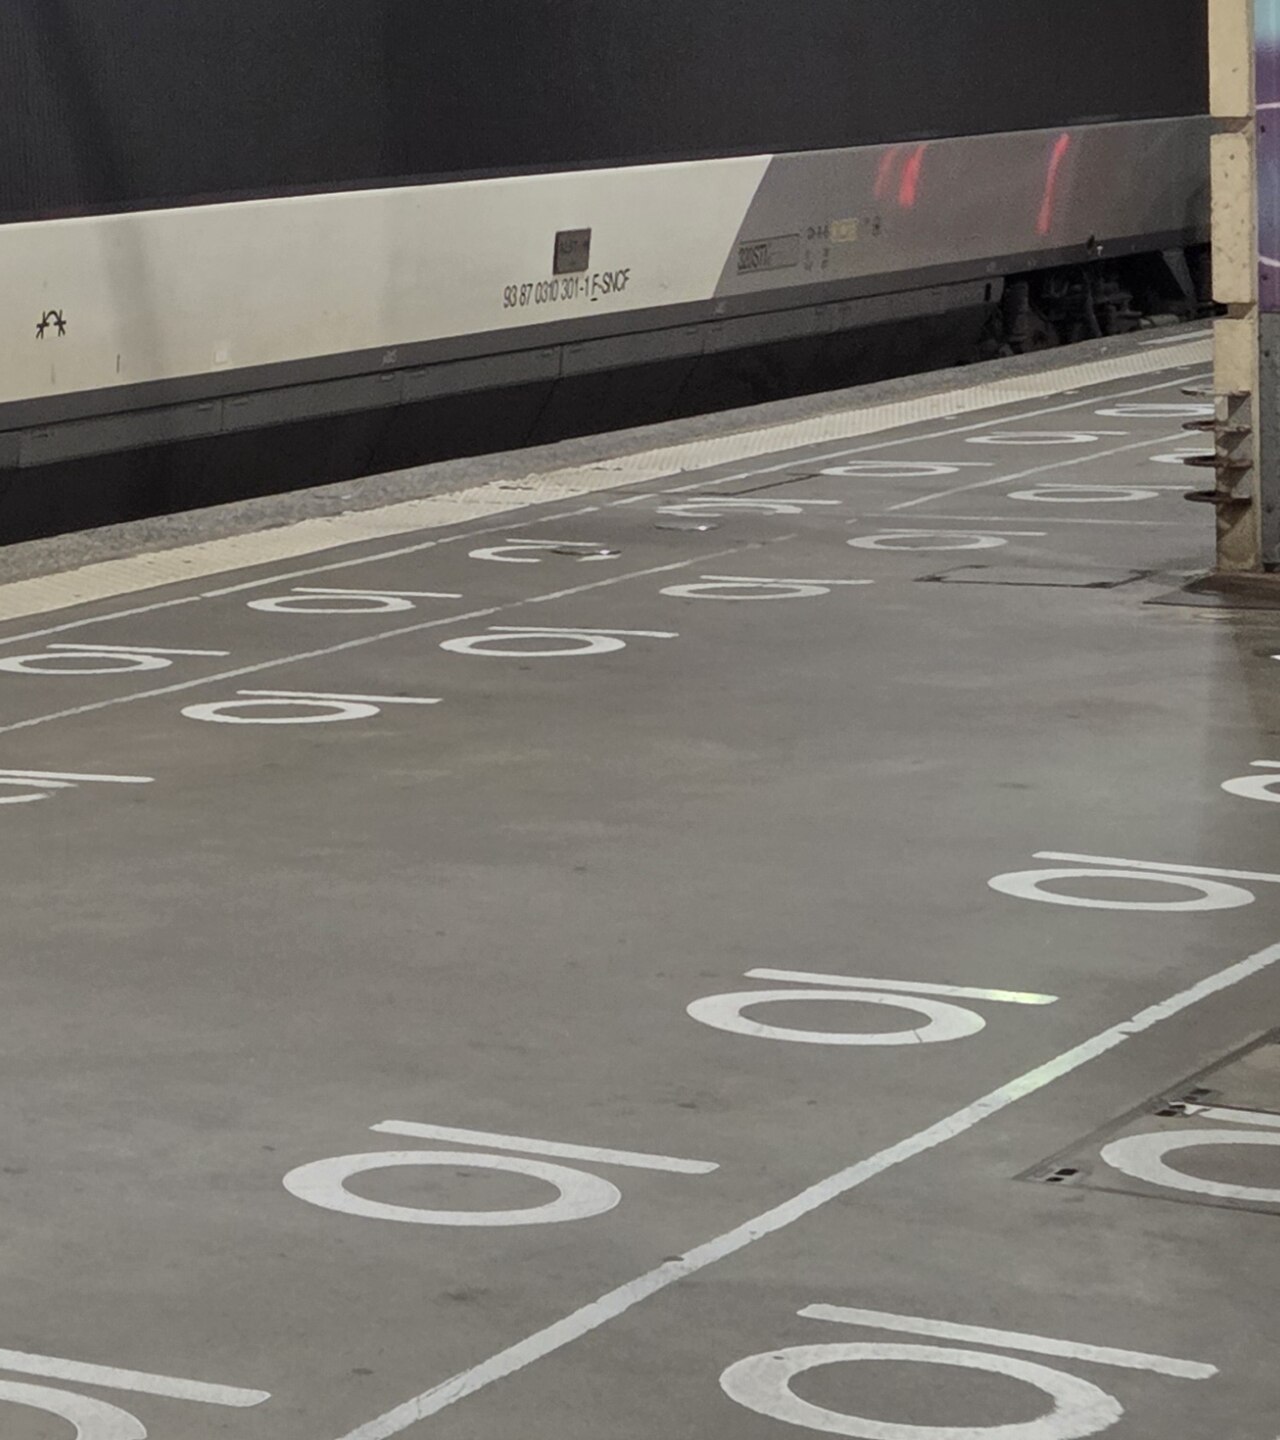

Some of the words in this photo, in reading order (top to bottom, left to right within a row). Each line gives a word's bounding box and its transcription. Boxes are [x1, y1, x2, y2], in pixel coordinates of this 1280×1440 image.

[503, 285, 518, 308] 93
[520, 283, 534, 306] 87
[535, 280, 559, 304] 0310
[561, 276, 589, 301] 301-1
